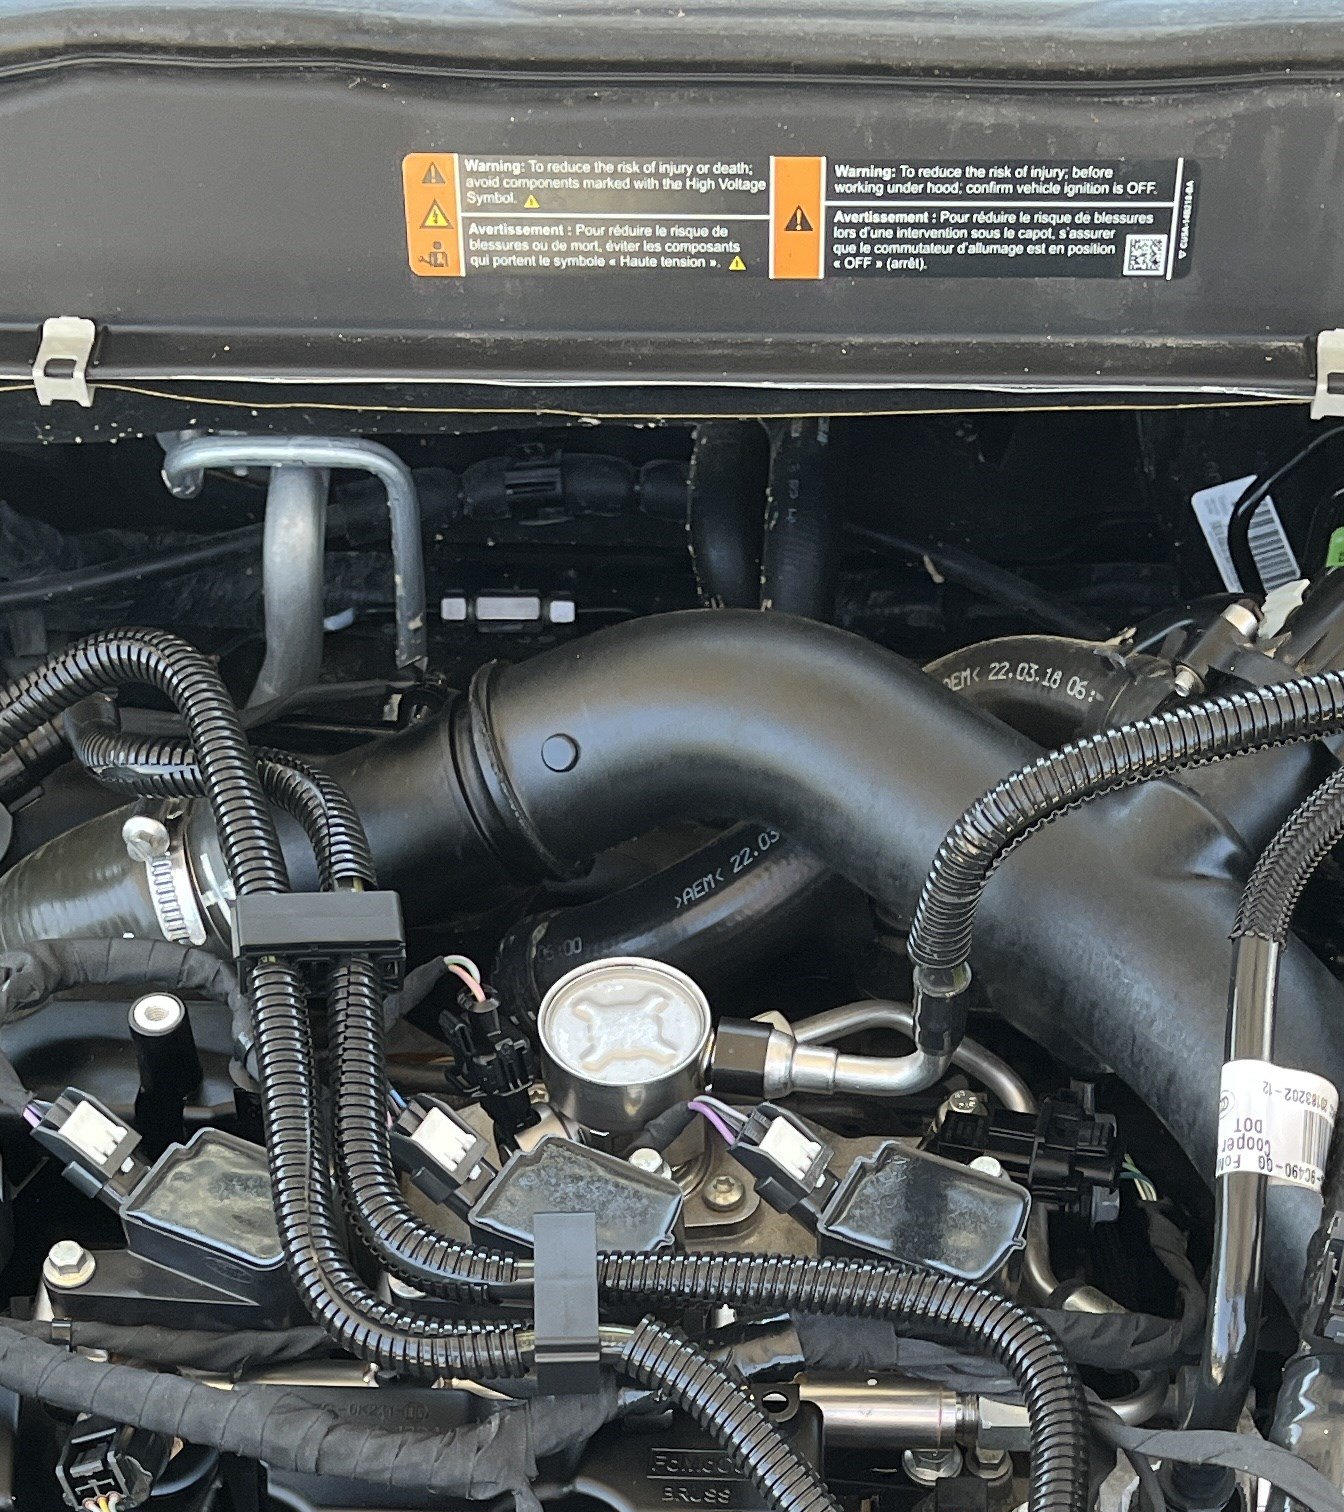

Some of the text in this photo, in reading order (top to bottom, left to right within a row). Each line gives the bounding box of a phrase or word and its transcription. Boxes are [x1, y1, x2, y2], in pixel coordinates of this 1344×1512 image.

[464, 159, 710, 177] Warning: To reduce the risk of injury or
[834, 164, 1114, 180] Warning: To reduce the risk of before
[466, 176, 767, 193] avoid components marked with the High Voltage
[834, 182, 1157, 197] working under confirm vehicle ignition is OFF.
[466, 192, 517, 206] Symbol.
[833, 210, 1154, 226] Avertissement Pour réduire le risque de blessures
[468, 223, 729, 240] Avertissement Pour réduire le risque de
[833, 226, 1116, 240] lors d'une intervention sous le s'assurer
[469, 238, 740, 255] blessures ou de éviter les composants
[833, 242, 1116, 258] que le commutateur d'allumage est en position
[470, 255, 705, 269] qui portent le symbole Haute tension
[844, 256, 928, 271] OFF (arrêt).
[987, 661, 1063, 689] 22.03.18
[1234, 1118, 1262, 1133] DOT
[1222, 1133, 1270, 1157] Cooper
